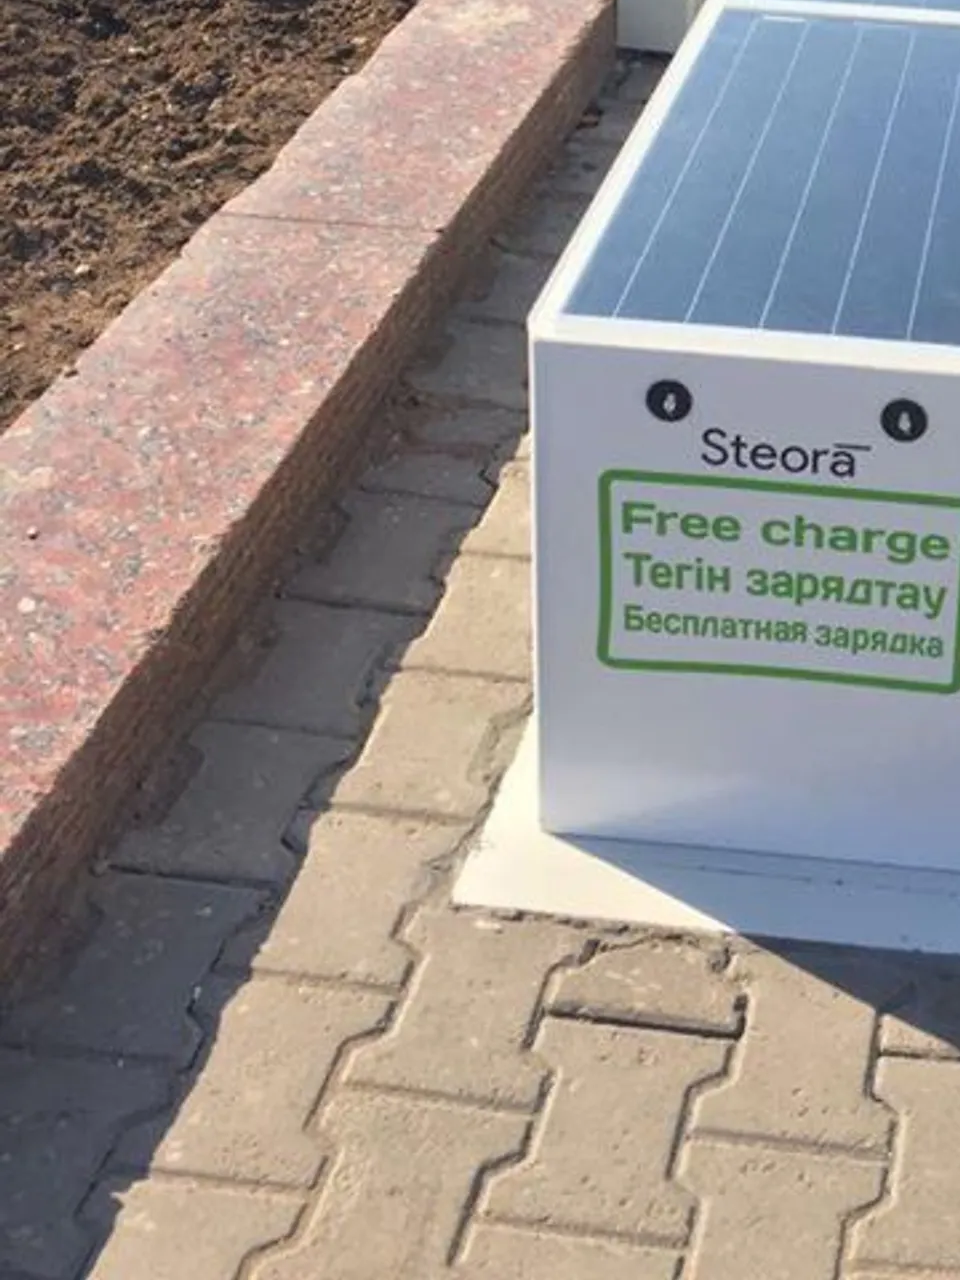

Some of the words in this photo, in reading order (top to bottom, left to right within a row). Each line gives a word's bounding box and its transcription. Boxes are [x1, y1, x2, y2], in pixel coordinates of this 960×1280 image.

[621, 501, 742, 542] Free
[760, 515, 951, 565] charge
[622, 552, 731, 593] Тегін
[745, 568, 948, 621] зарядтау
[623, 604, 808, 643] Бесплатная
[814, 621, 944, 659] зарядка
